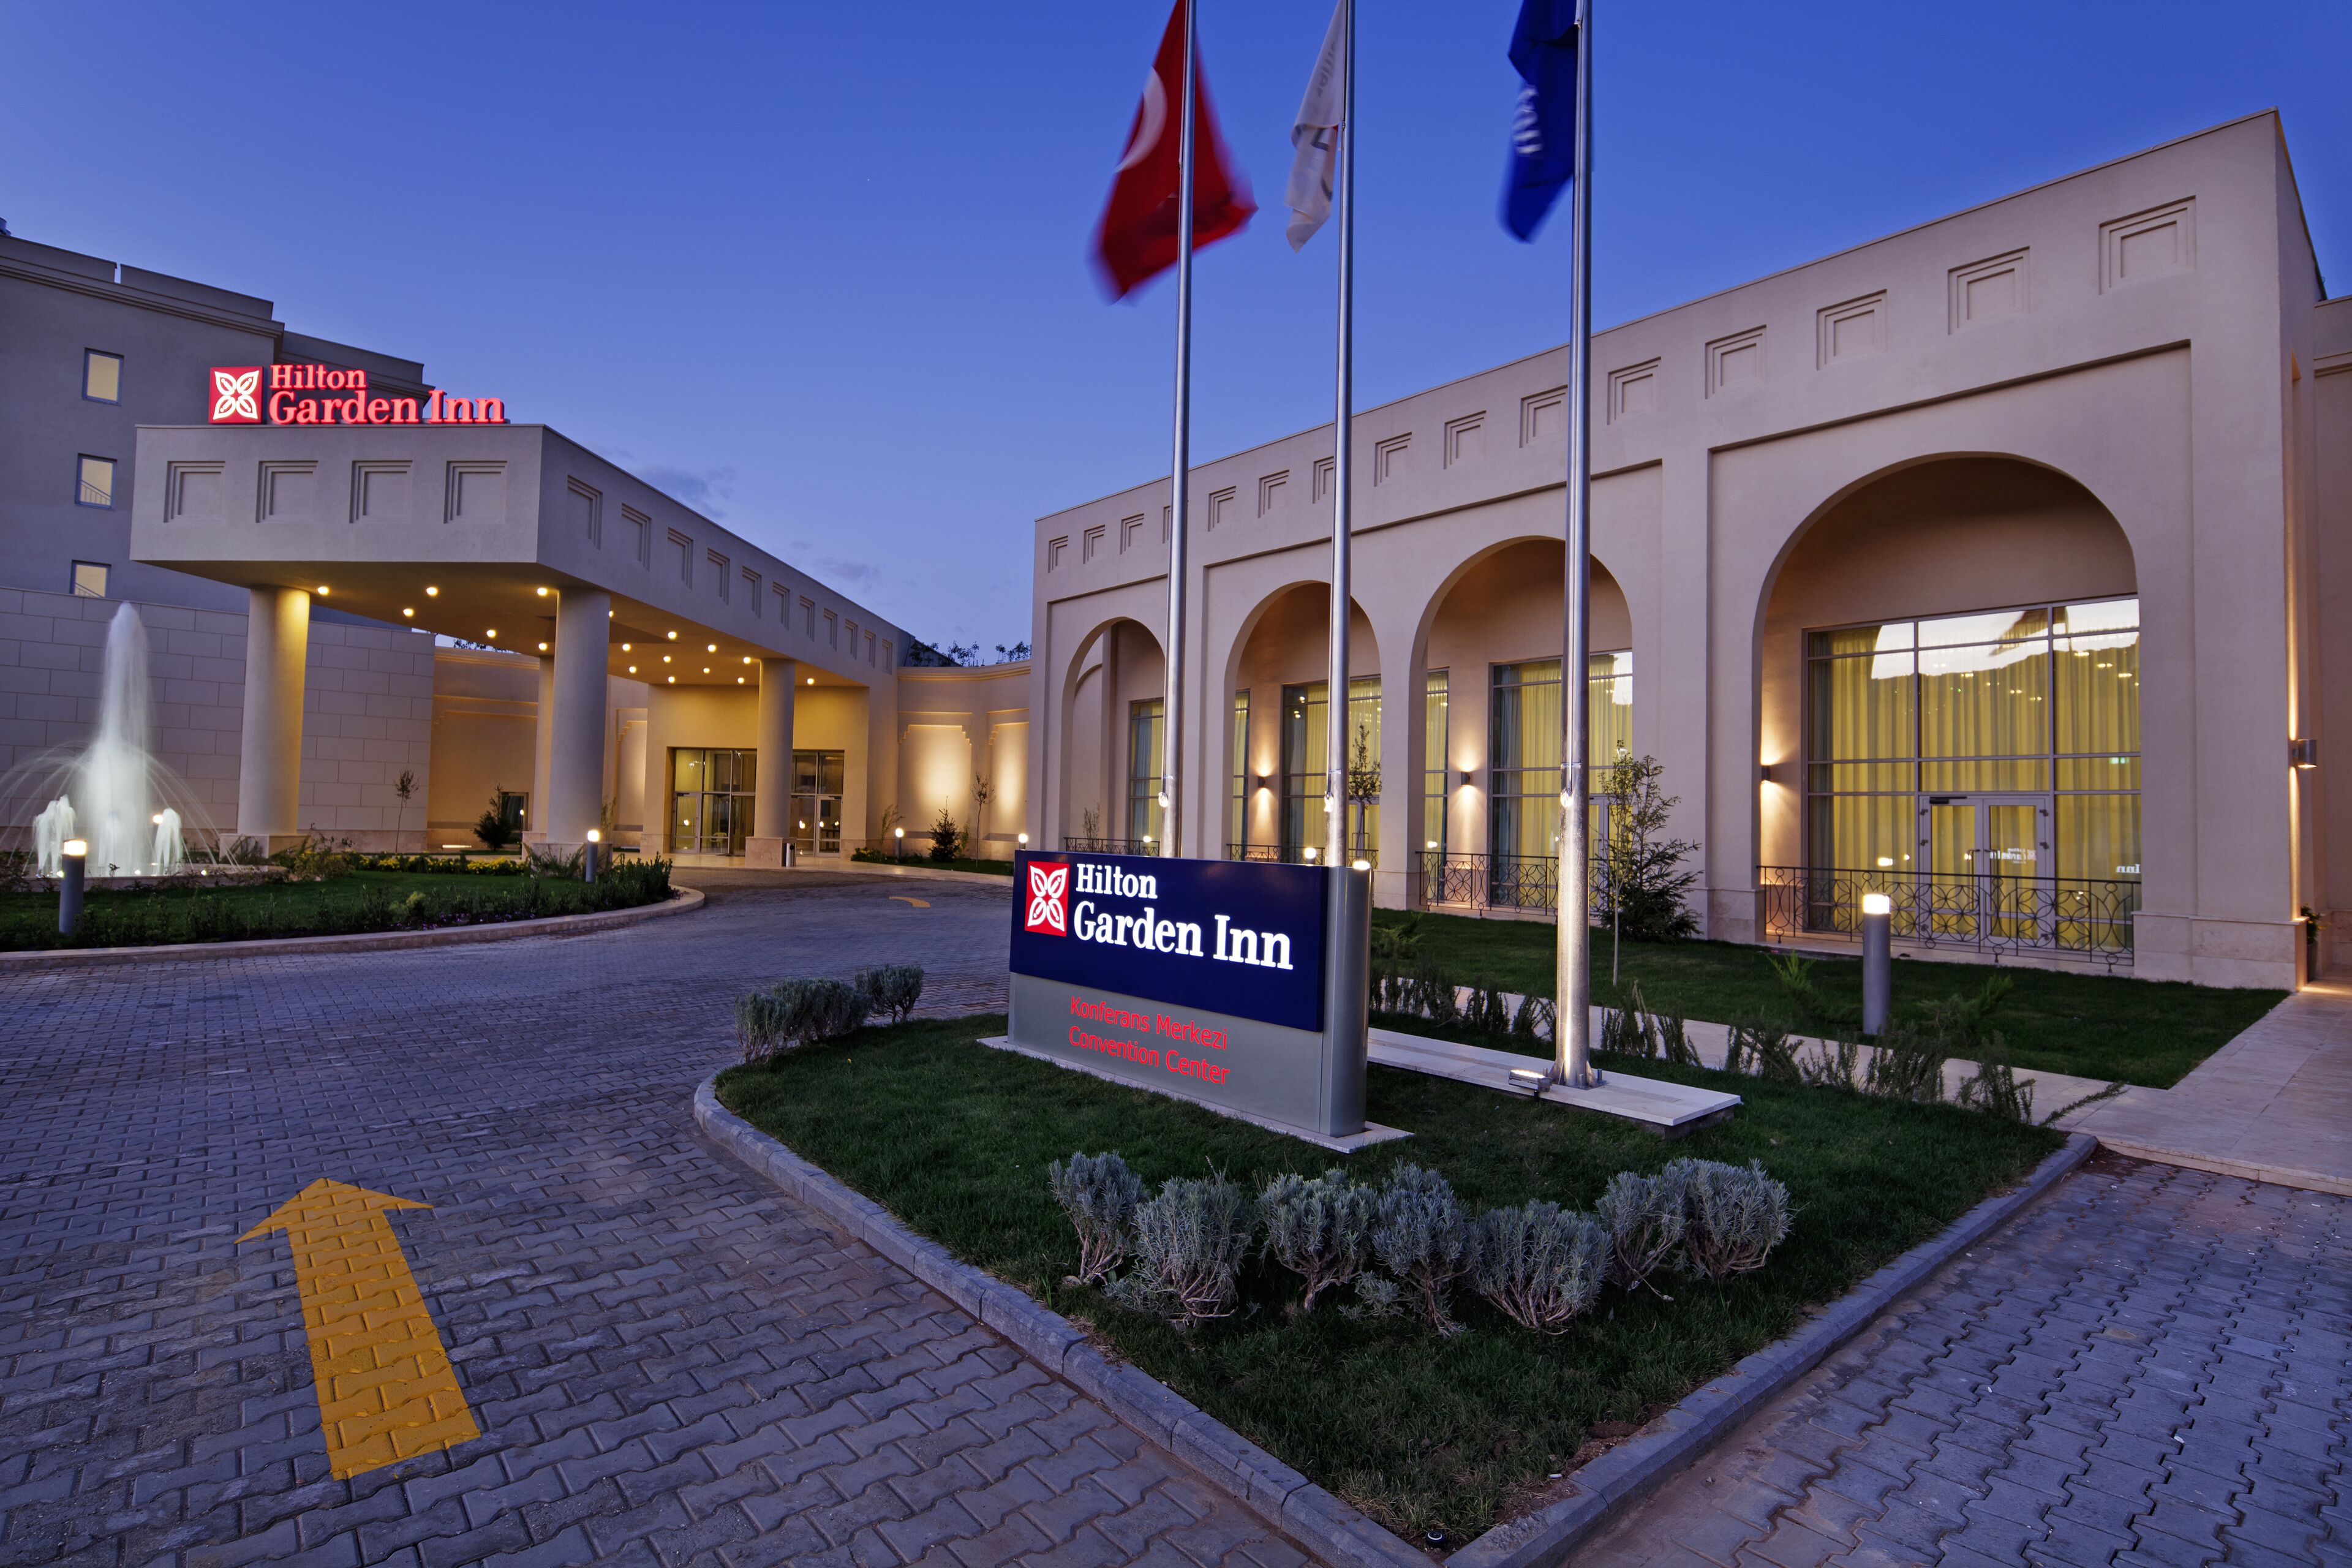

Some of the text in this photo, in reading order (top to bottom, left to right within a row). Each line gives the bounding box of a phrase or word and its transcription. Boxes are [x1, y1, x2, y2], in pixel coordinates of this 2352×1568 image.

[270, 364, 368, 390] Hilton
[268, 390, 505, 424] Garden Inn
[1076, 864, 1158, 899] Hilton
[1074, 900, 1294, 970] Garden Inn
[1071, 995, 1227, 1050] Konferans Merkezi
[1069, 1025, 1231, 1085] Convention Center
